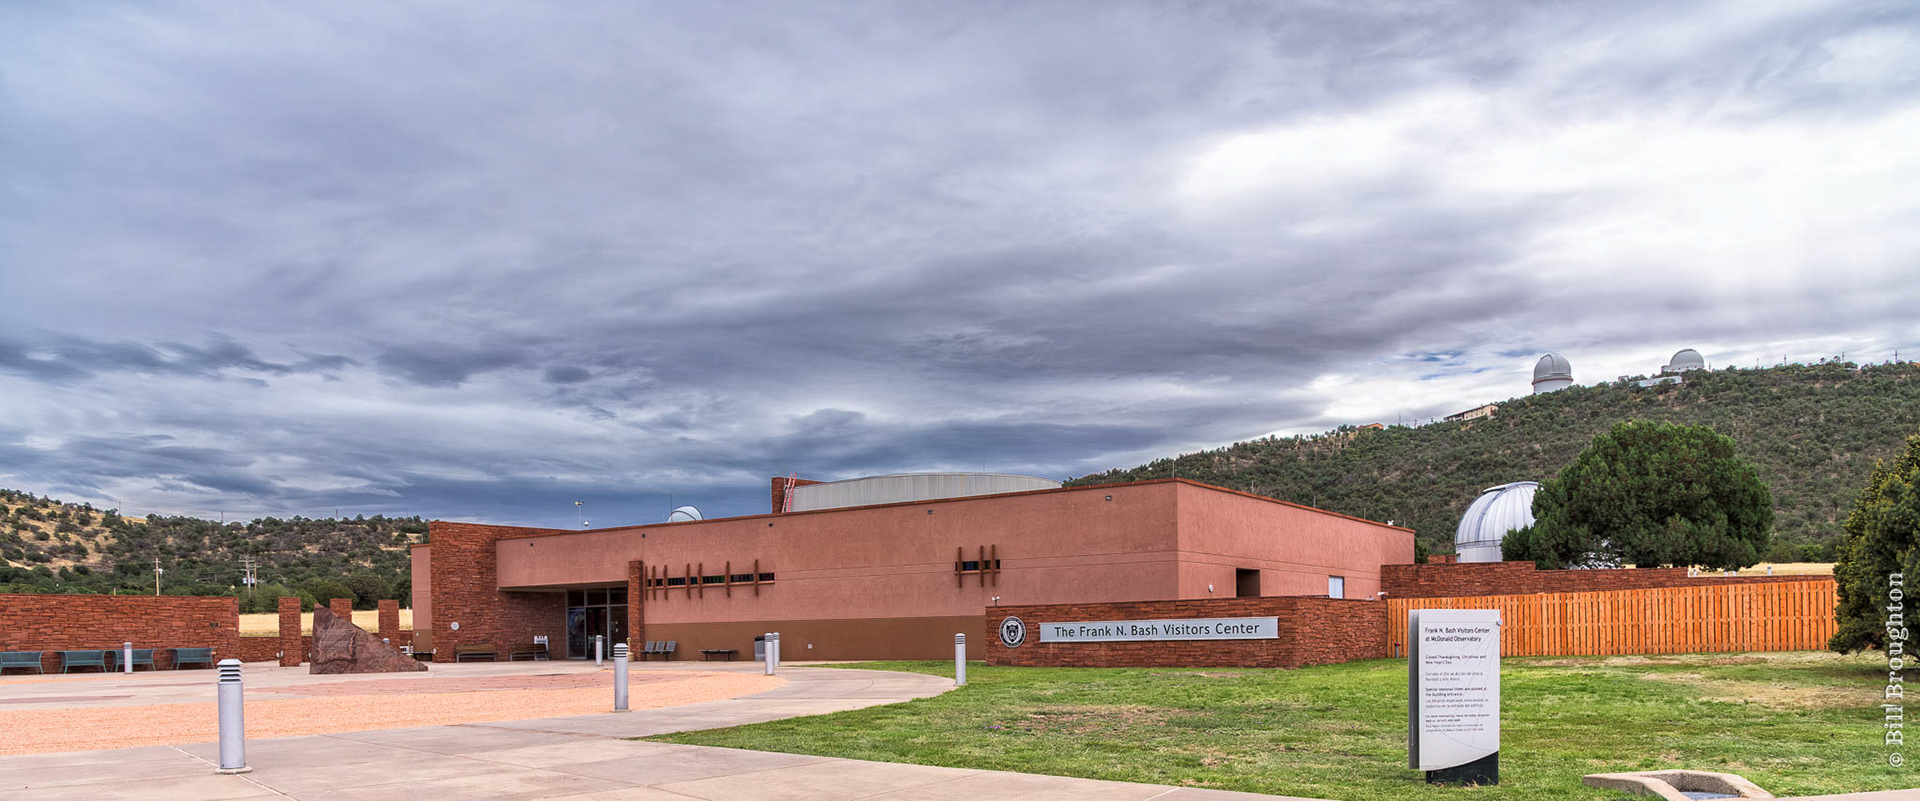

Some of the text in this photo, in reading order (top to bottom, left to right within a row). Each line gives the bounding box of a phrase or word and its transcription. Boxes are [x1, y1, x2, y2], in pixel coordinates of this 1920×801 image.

[1054, 623, 1260, 638] The Frank N. Bash Visitors Center
